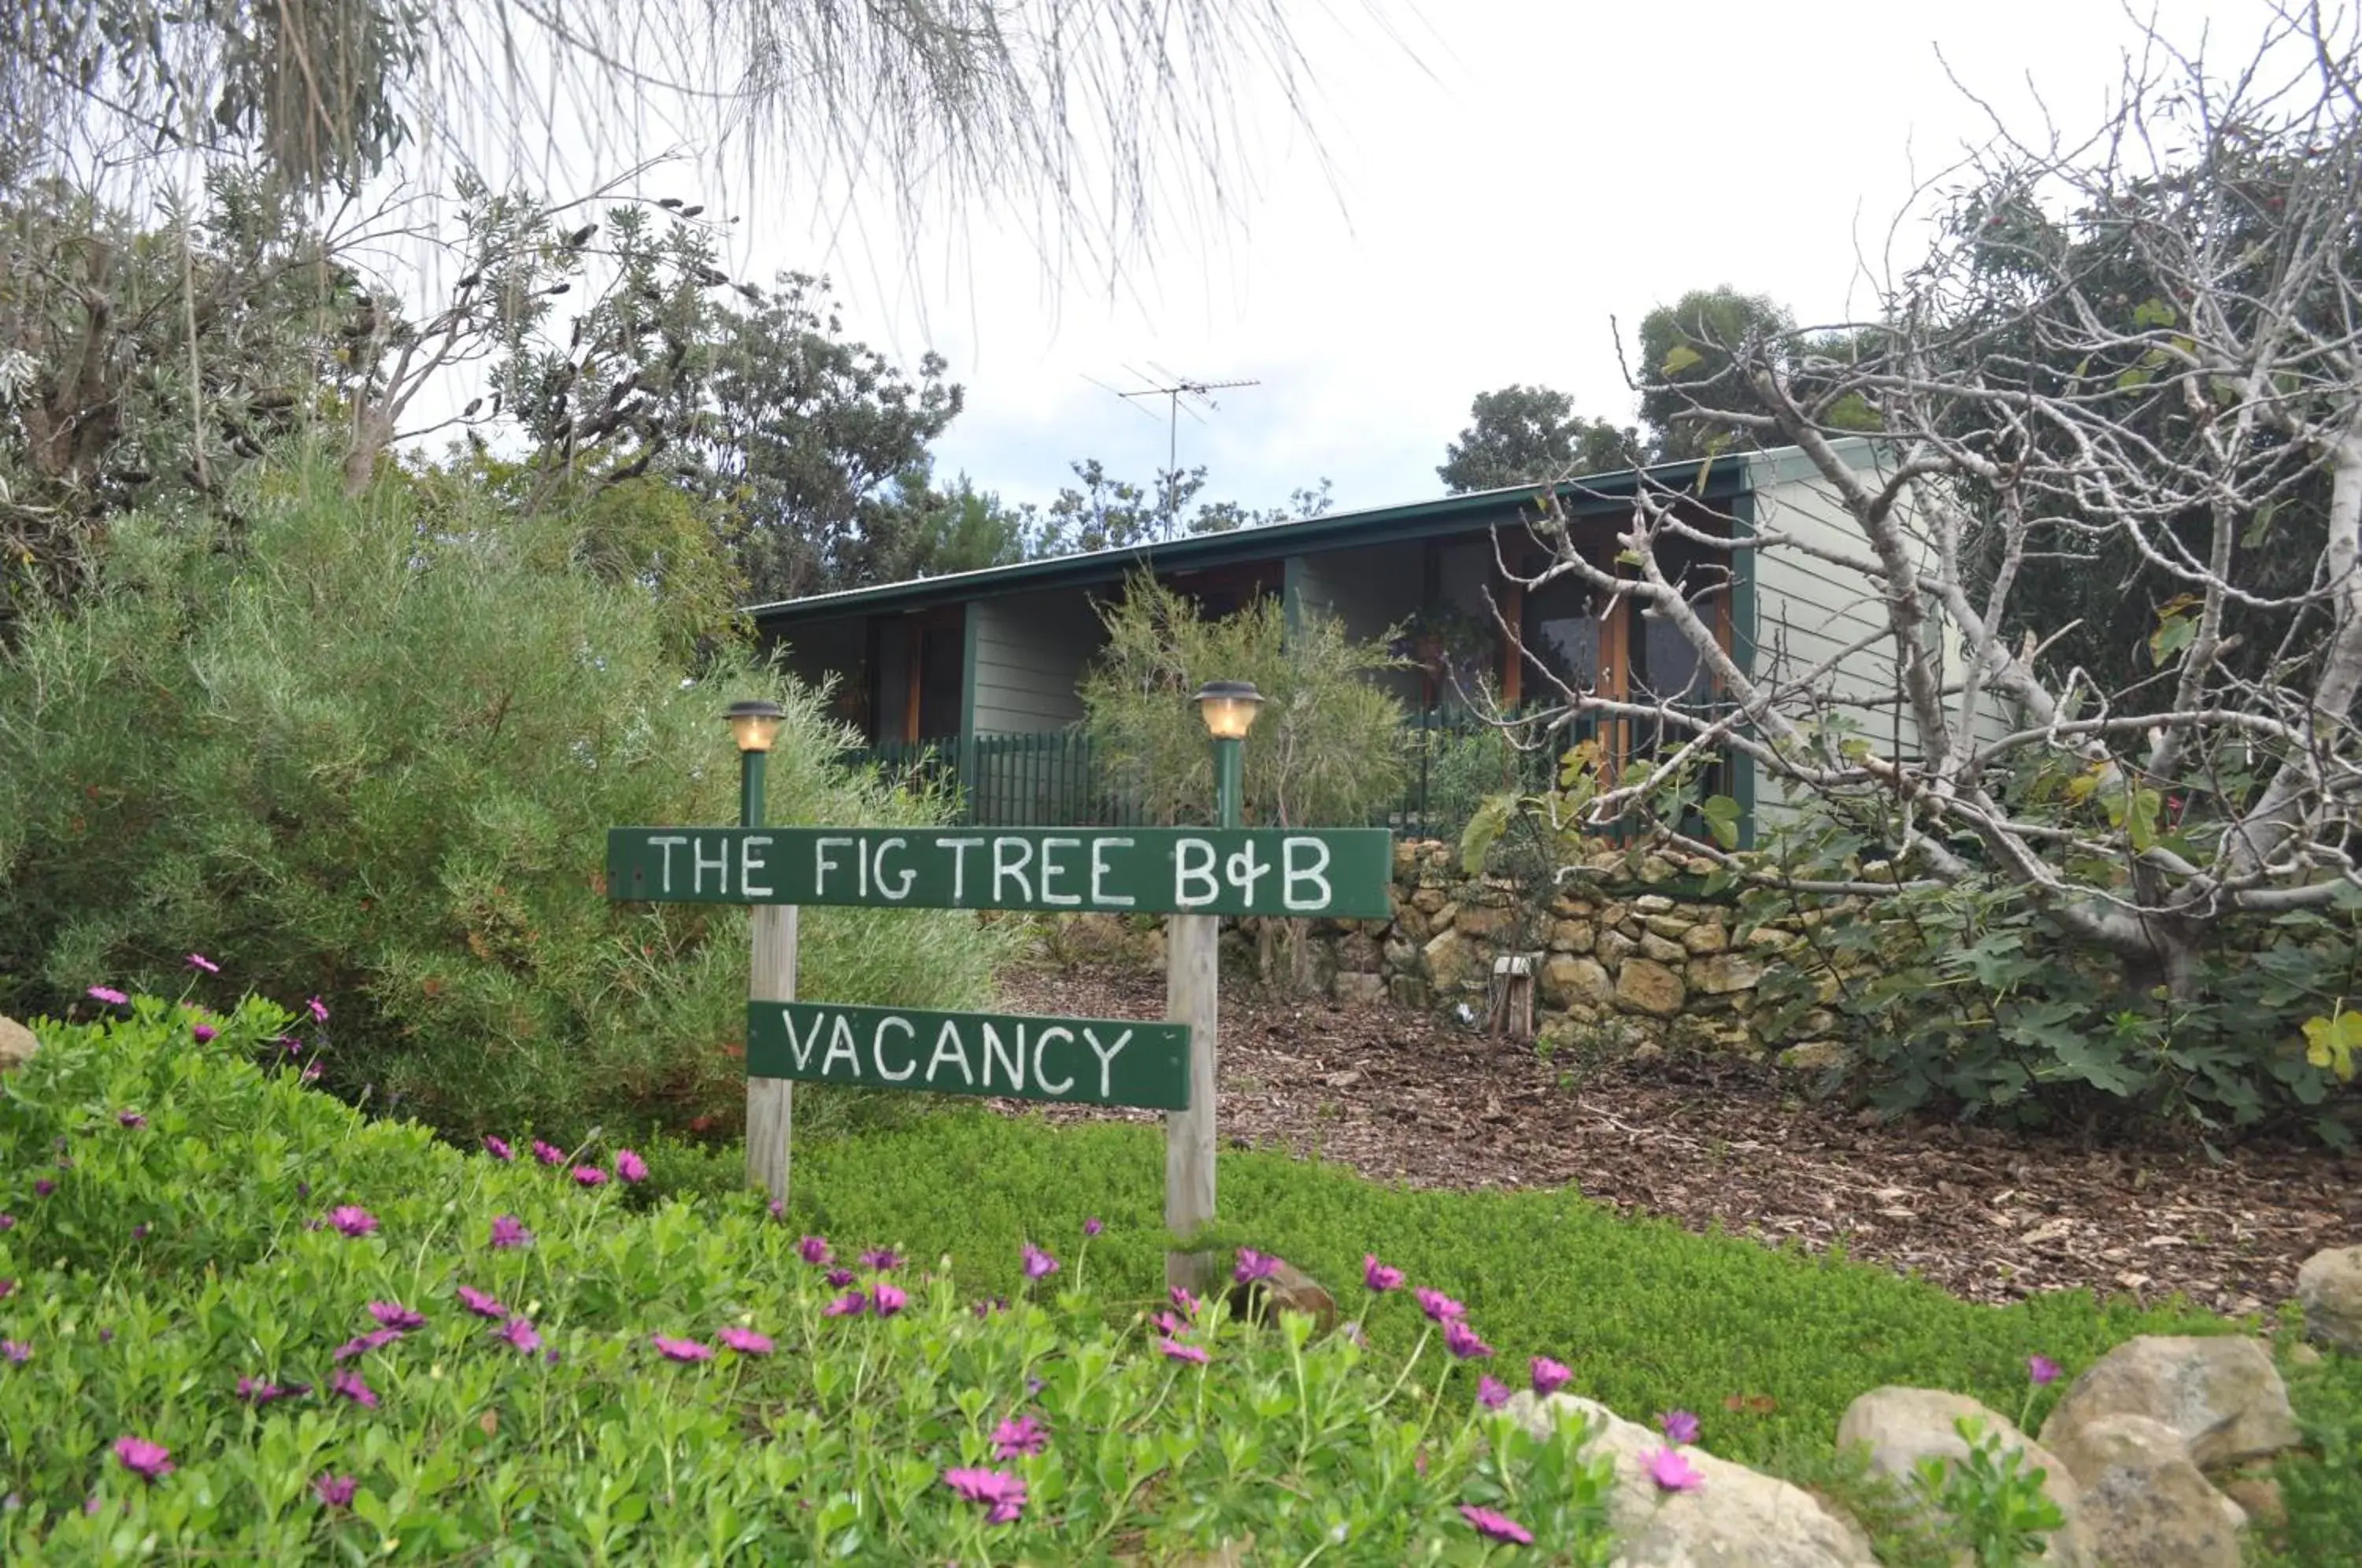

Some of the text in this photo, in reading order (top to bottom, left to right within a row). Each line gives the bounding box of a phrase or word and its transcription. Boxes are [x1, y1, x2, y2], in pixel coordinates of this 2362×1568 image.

[647, 835, 1332, 910] THE FIG TREE B&B
[782, 1009, 1134, 1098] VACANCY
